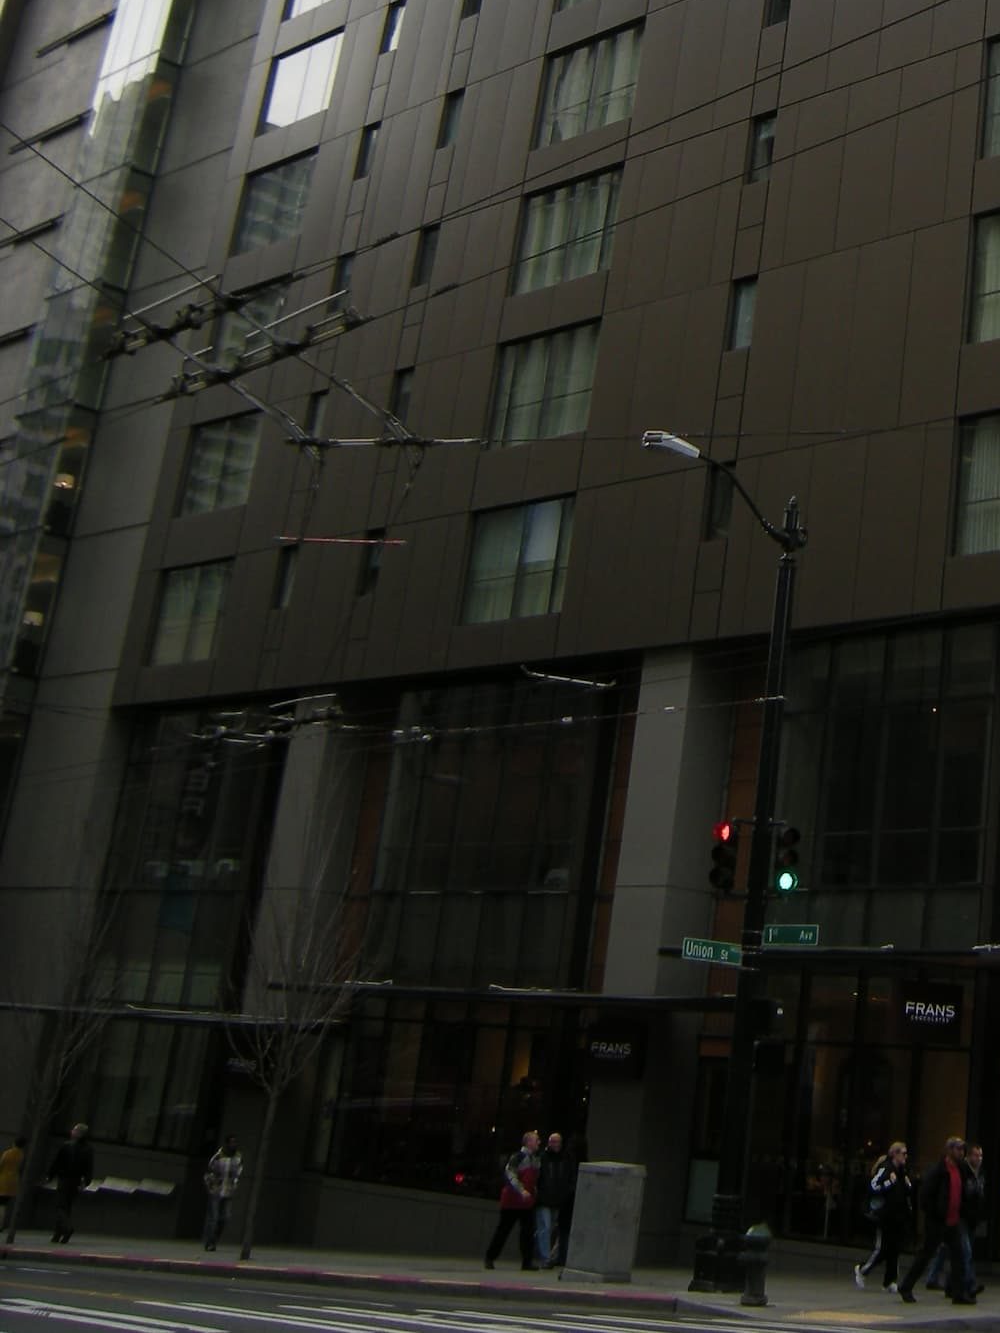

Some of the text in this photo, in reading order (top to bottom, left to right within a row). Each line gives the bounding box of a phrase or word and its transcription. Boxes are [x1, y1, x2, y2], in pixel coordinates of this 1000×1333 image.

[799, 929, 813, 941] Ave
[686, 940, 728, 961] Union St
[905, 1001, 956, 1018] FRANS
[591, 1041, 632, 1055] FRANS
